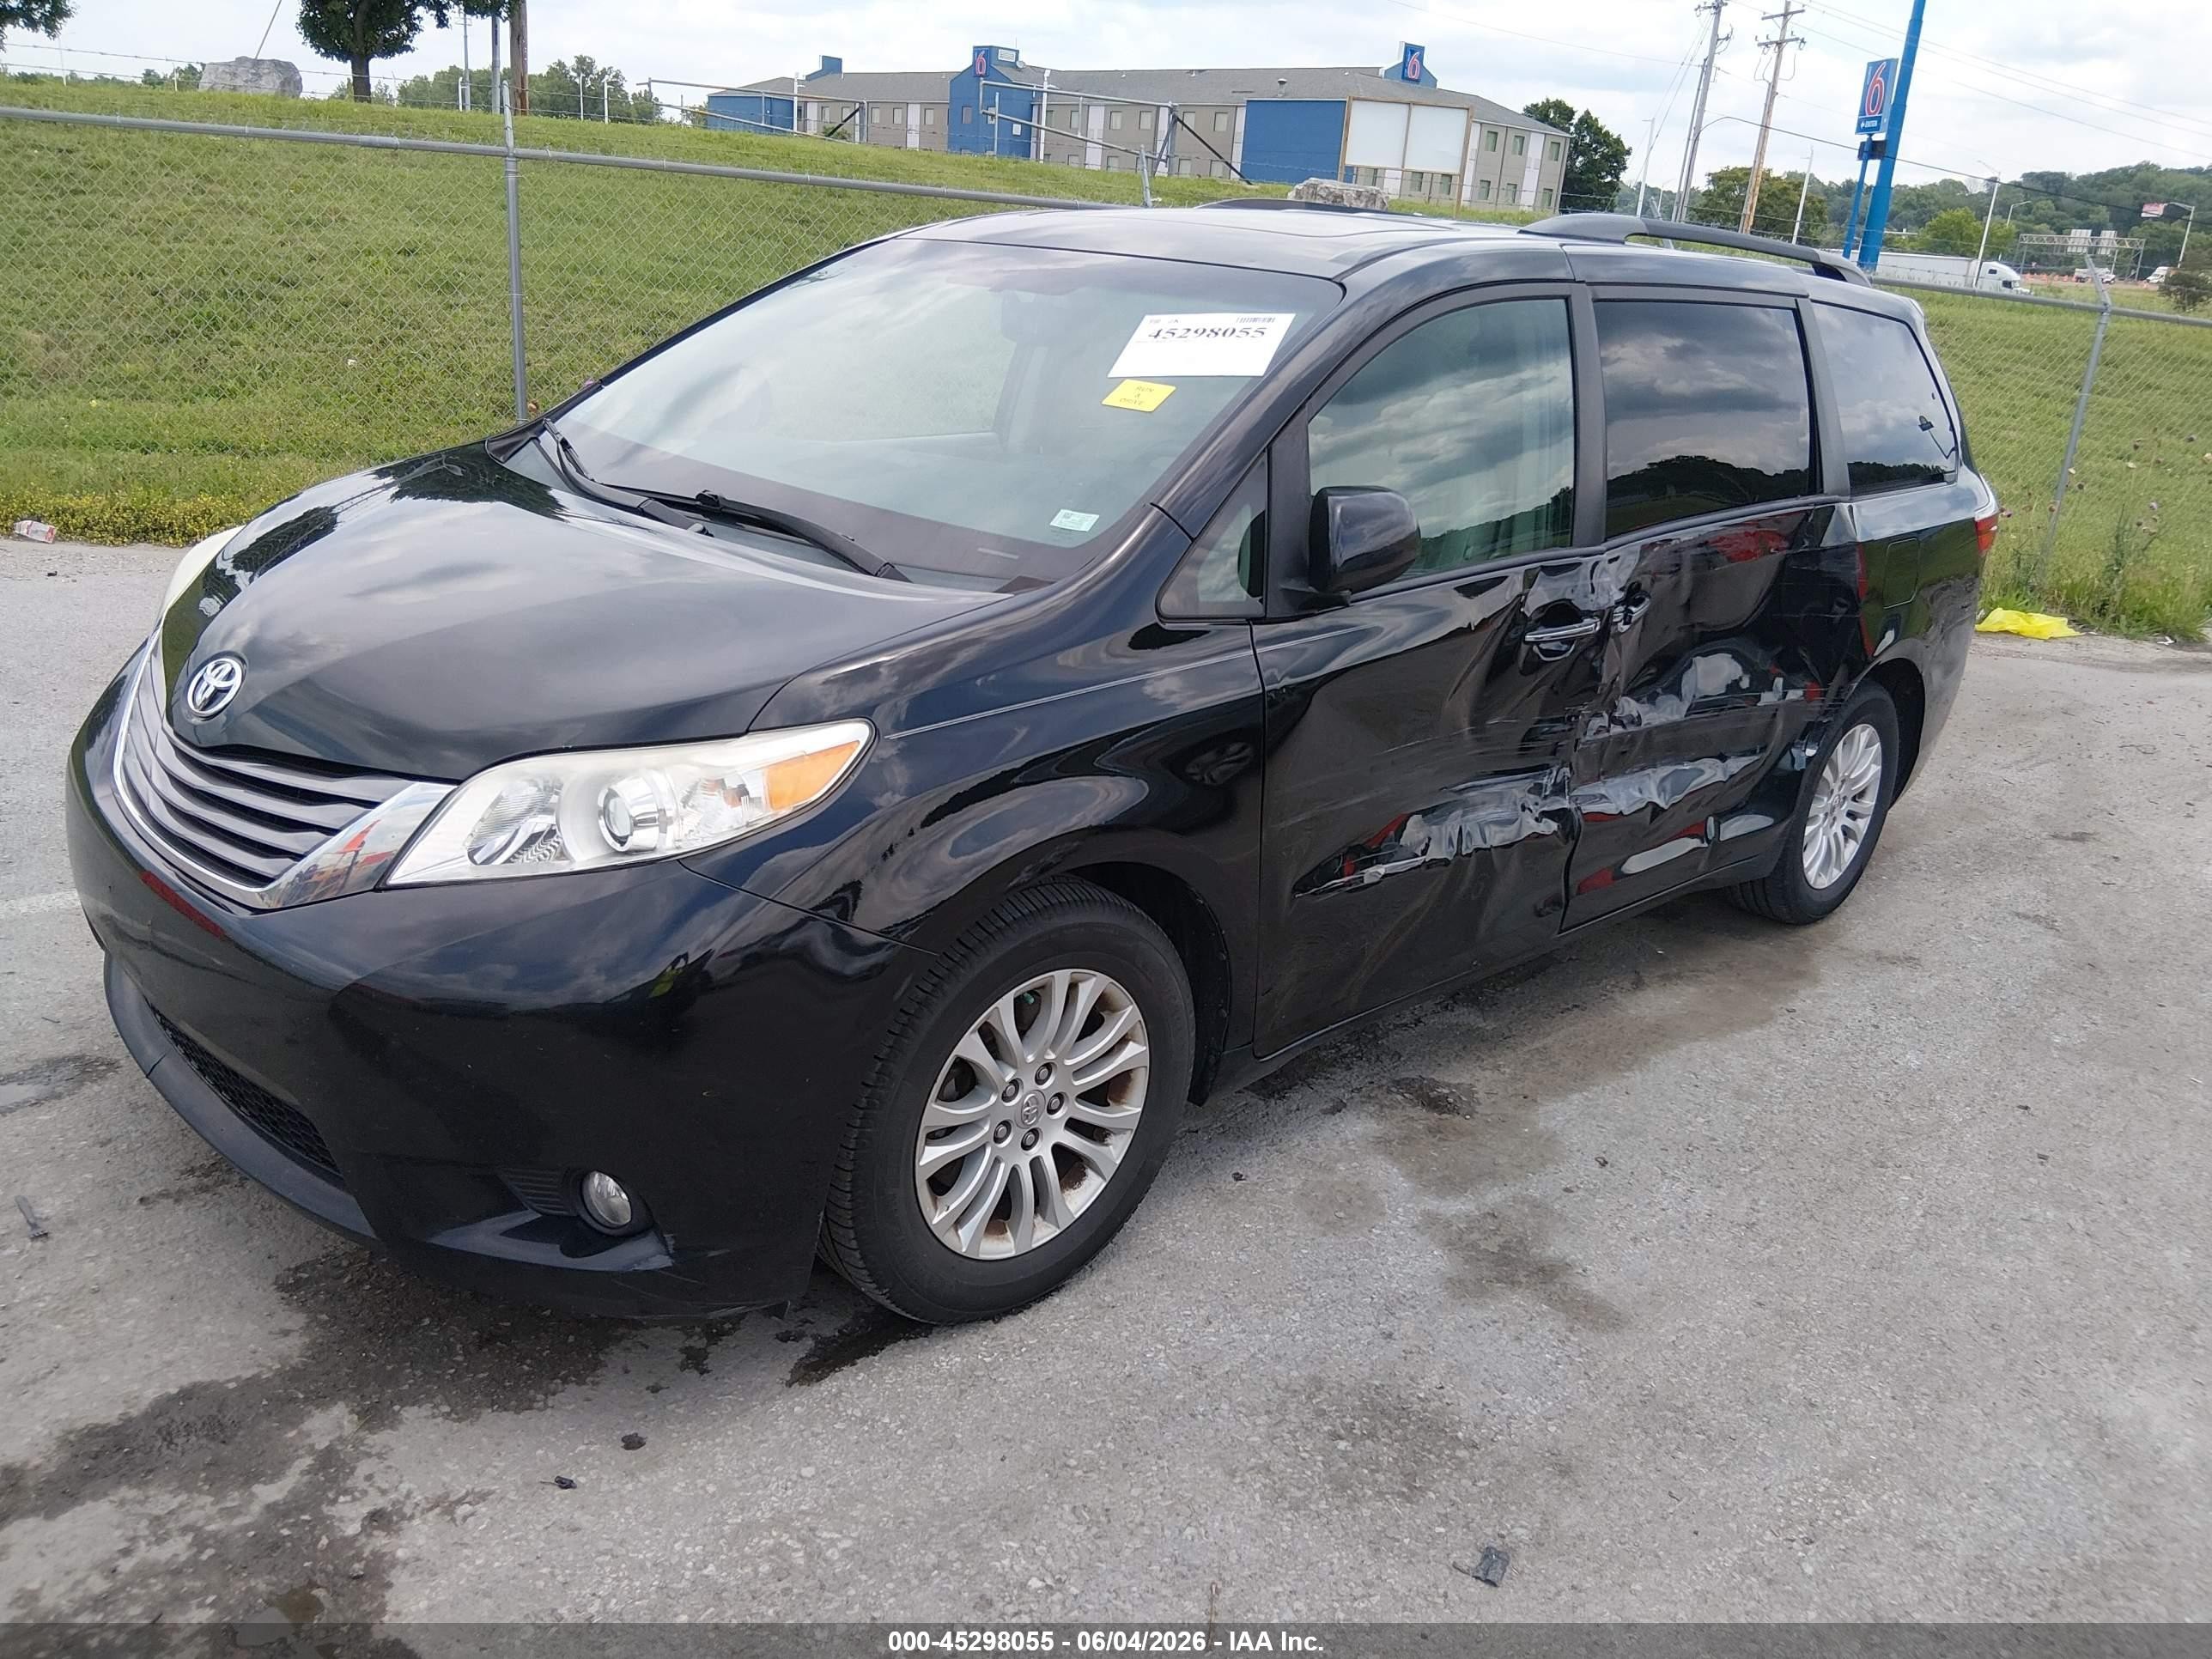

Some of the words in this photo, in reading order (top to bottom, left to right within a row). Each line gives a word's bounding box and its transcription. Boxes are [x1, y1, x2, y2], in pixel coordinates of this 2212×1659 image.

[975, 51, 987, 76] 6
[1408, 52, 1420, 79] 6
[1865, 61, 1887, 116] 6
[1148, 327, 1267, 339] 45298055
